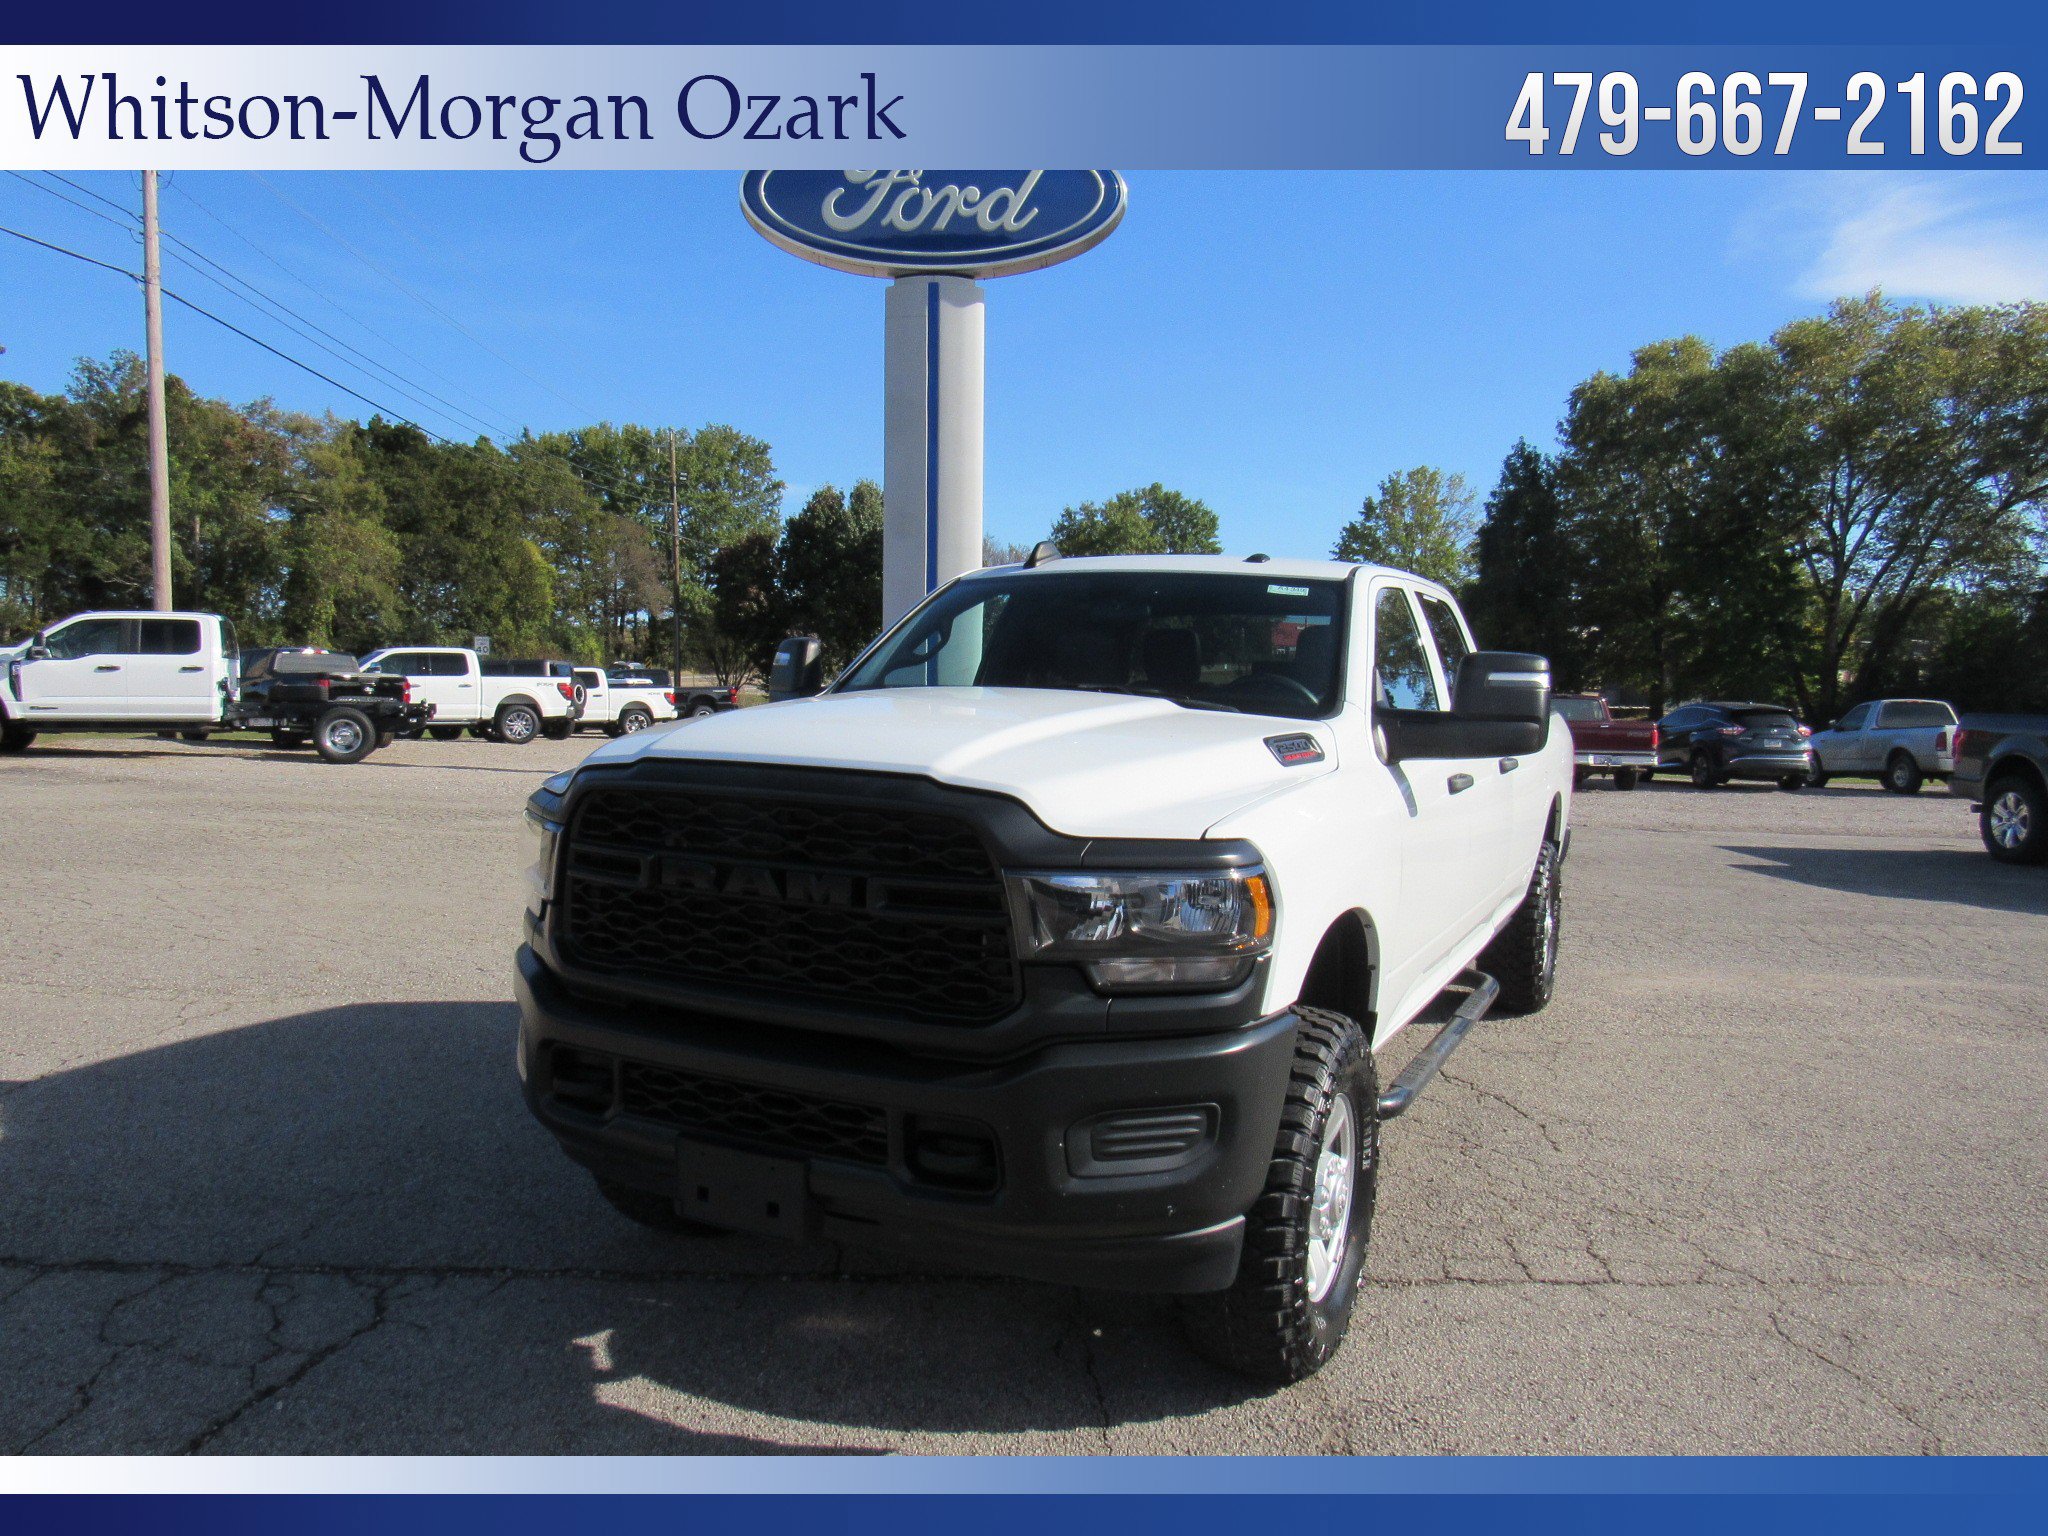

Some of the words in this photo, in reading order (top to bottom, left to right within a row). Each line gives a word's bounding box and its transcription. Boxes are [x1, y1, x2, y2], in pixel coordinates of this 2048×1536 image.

[821, 170, 1039, 232] Ford
[1276, 741, 1310, 754] 2500
[660, 861, 854, 906] RAM
